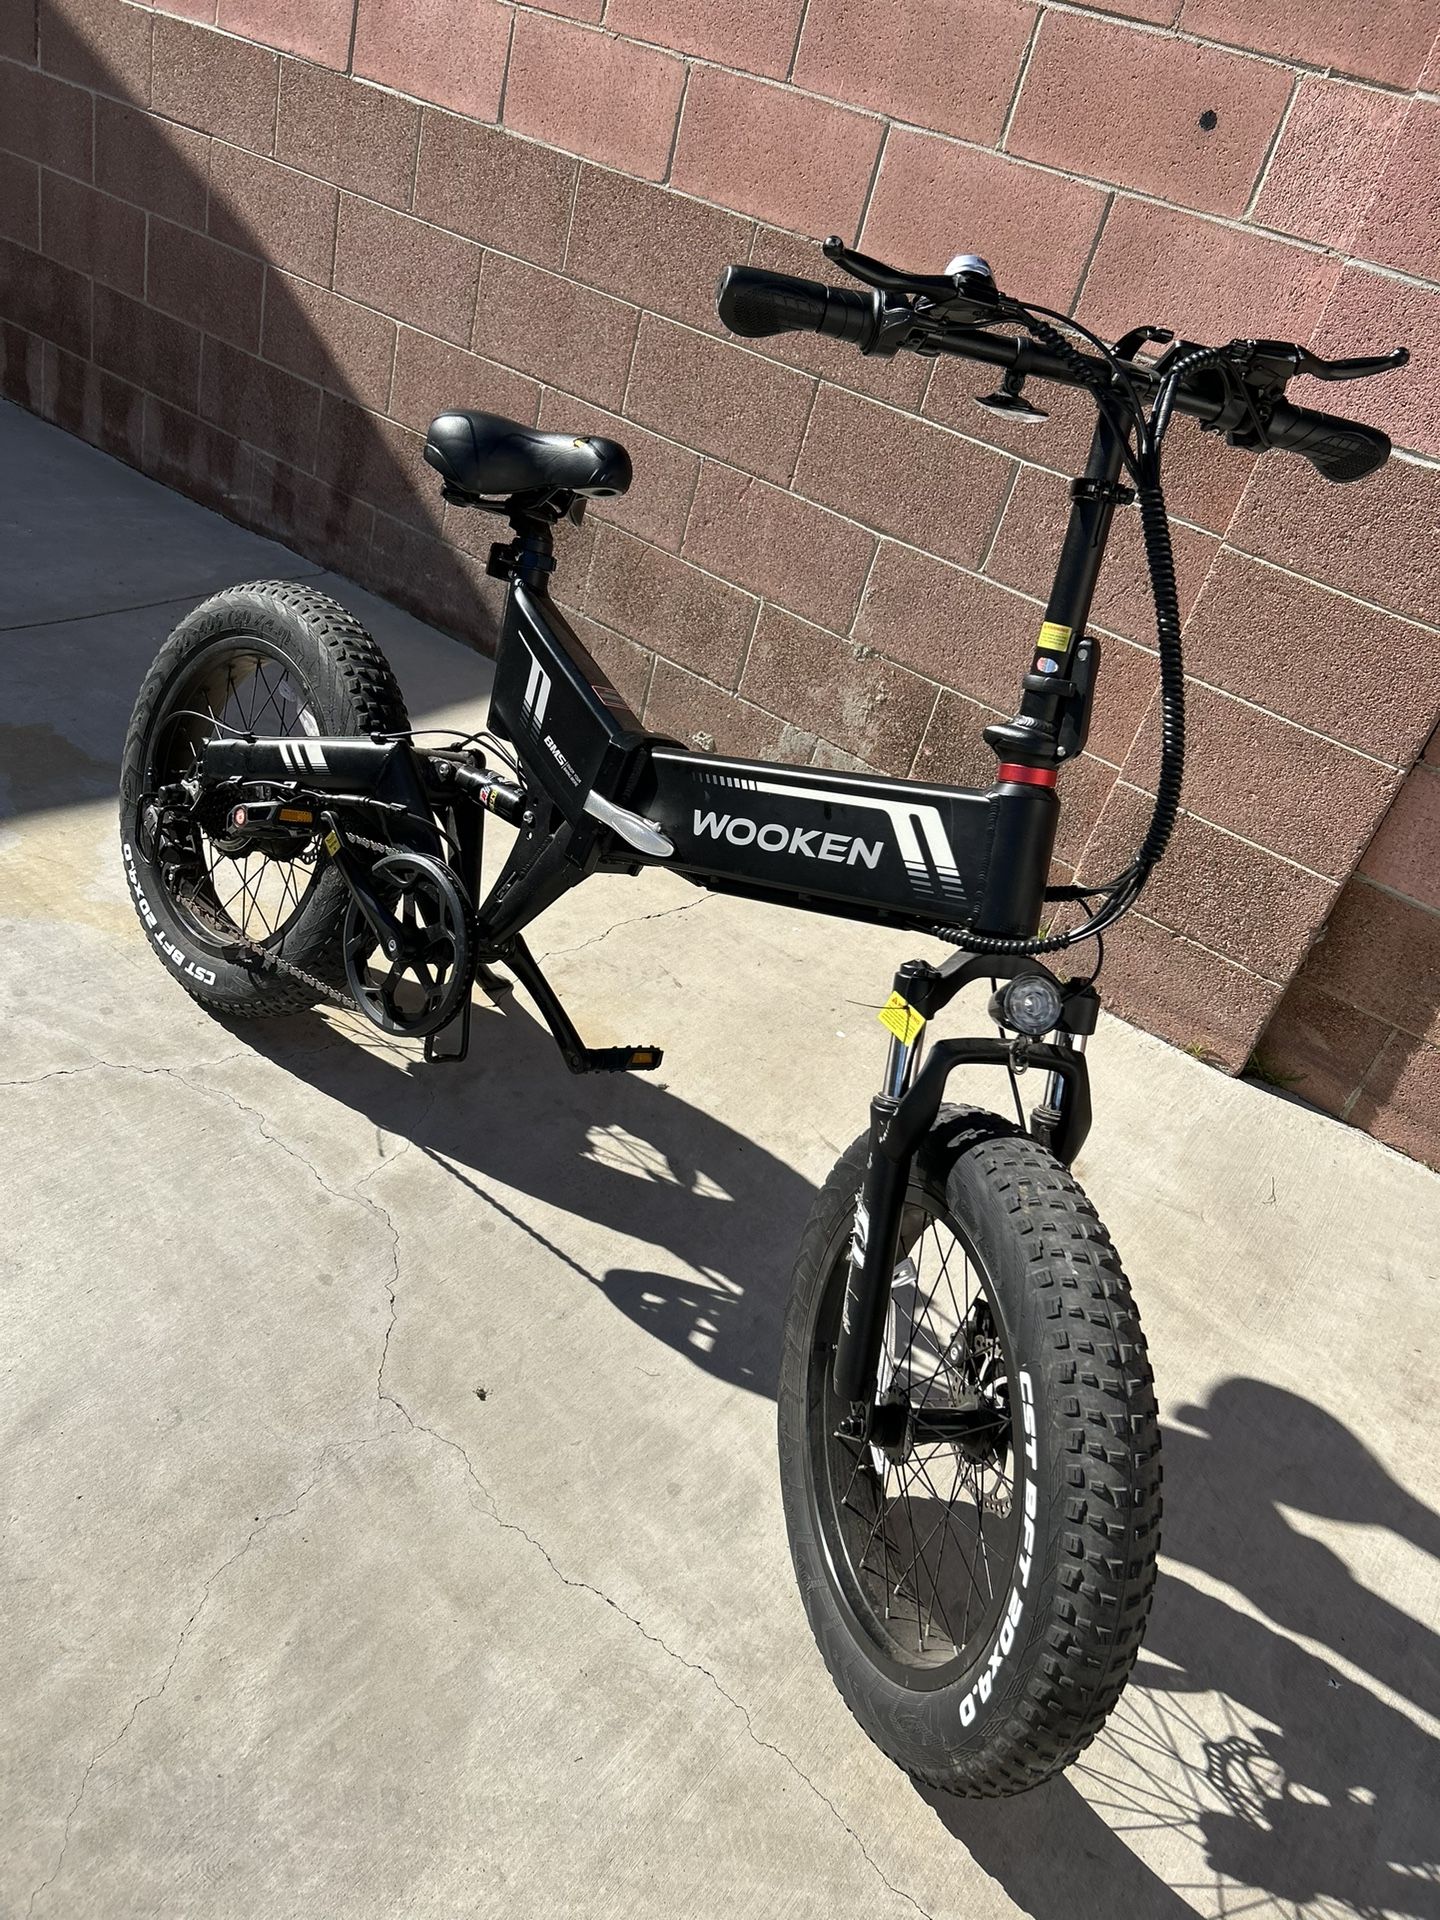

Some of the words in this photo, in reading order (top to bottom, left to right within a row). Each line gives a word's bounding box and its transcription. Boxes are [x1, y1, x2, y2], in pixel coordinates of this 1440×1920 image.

[543, 735, 567, 766] BMS
[693, 809, 884, 870] WOOKEN
[154, 930, 187, 967] BFT
[184, 961, 216, 986] CST
[1019, 1370, 1037, 1471] CST
[1018, 1478, 1037, 1588] BFT
